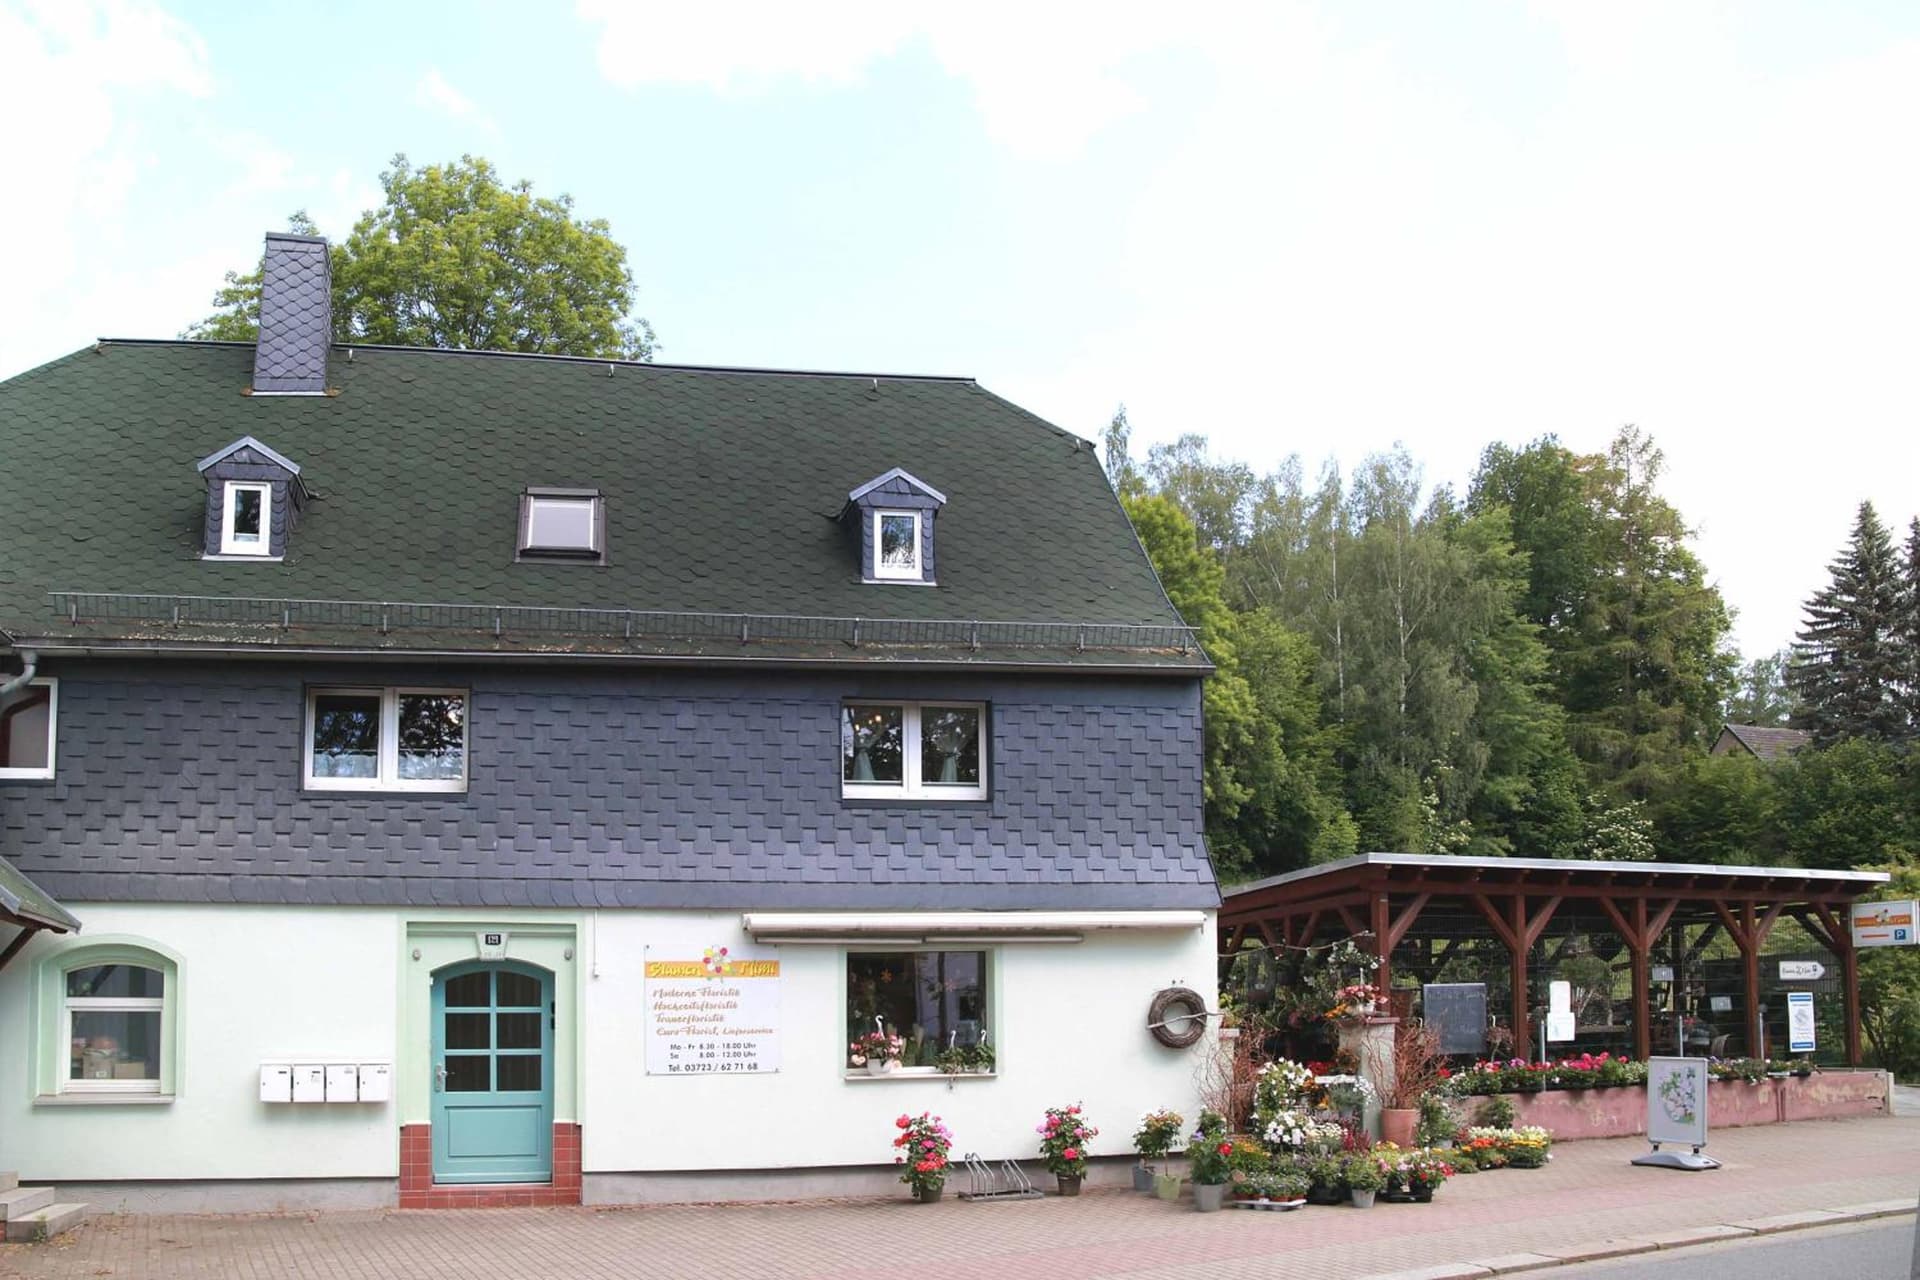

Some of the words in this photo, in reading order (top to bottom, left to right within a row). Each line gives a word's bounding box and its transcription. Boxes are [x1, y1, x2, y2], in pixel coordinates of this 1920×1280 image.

[653, 988, 697, 998] Moderne
[697, 986, 740, 997] Floristik
[653, 1000, 738, 1011] Hochzeitsfloristik
[655, 1013, 724, 1024] Trauerfloristik
[668, 1064, 682, 1072] Tel.
[684, 1063, 712, 1072] 03723
[721, 1063, 732, 1071] 62
[747, 1062, 758, 1070] 68
